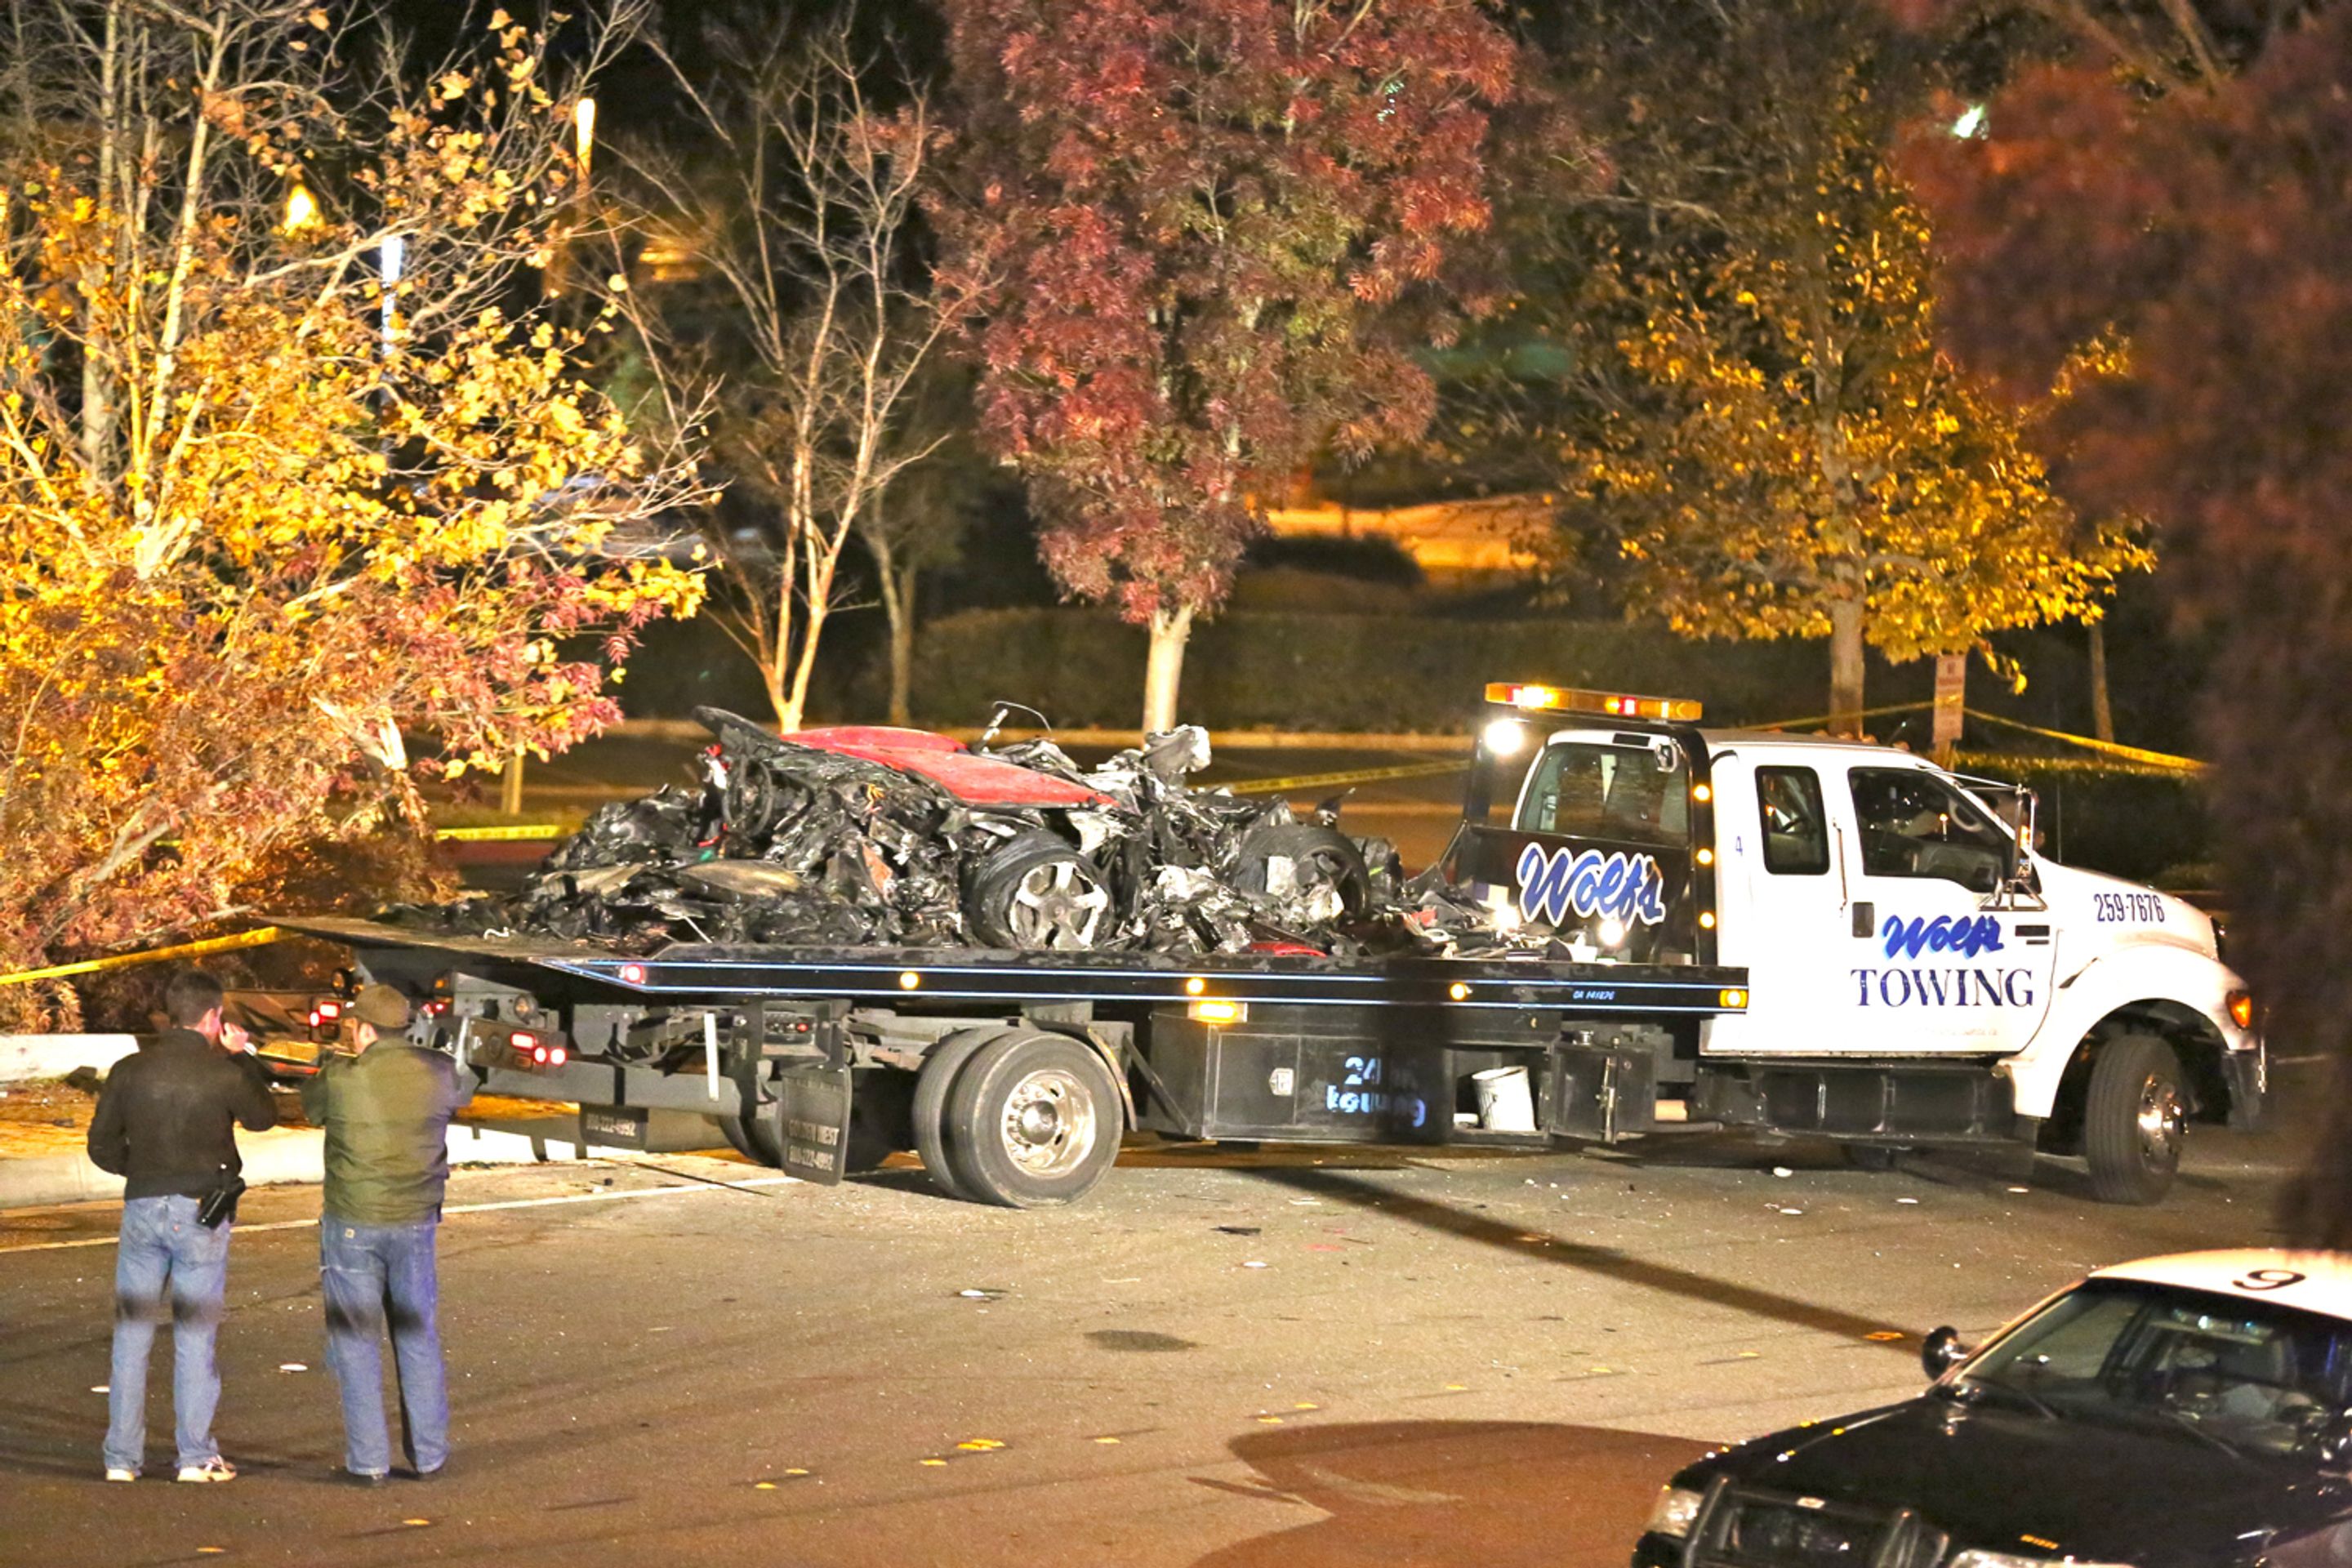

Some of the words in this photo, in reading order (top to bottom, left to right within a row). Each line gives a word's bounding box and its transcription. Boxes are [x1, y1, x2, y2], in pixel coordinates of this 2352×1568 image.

[2093, 893, 2165, 923] 259-7676
[1851, 969, 2034, 1007] TOWING
[817, 1125, 840, 1147] WEST
[2232, 1269, 2306, 1292] 9
